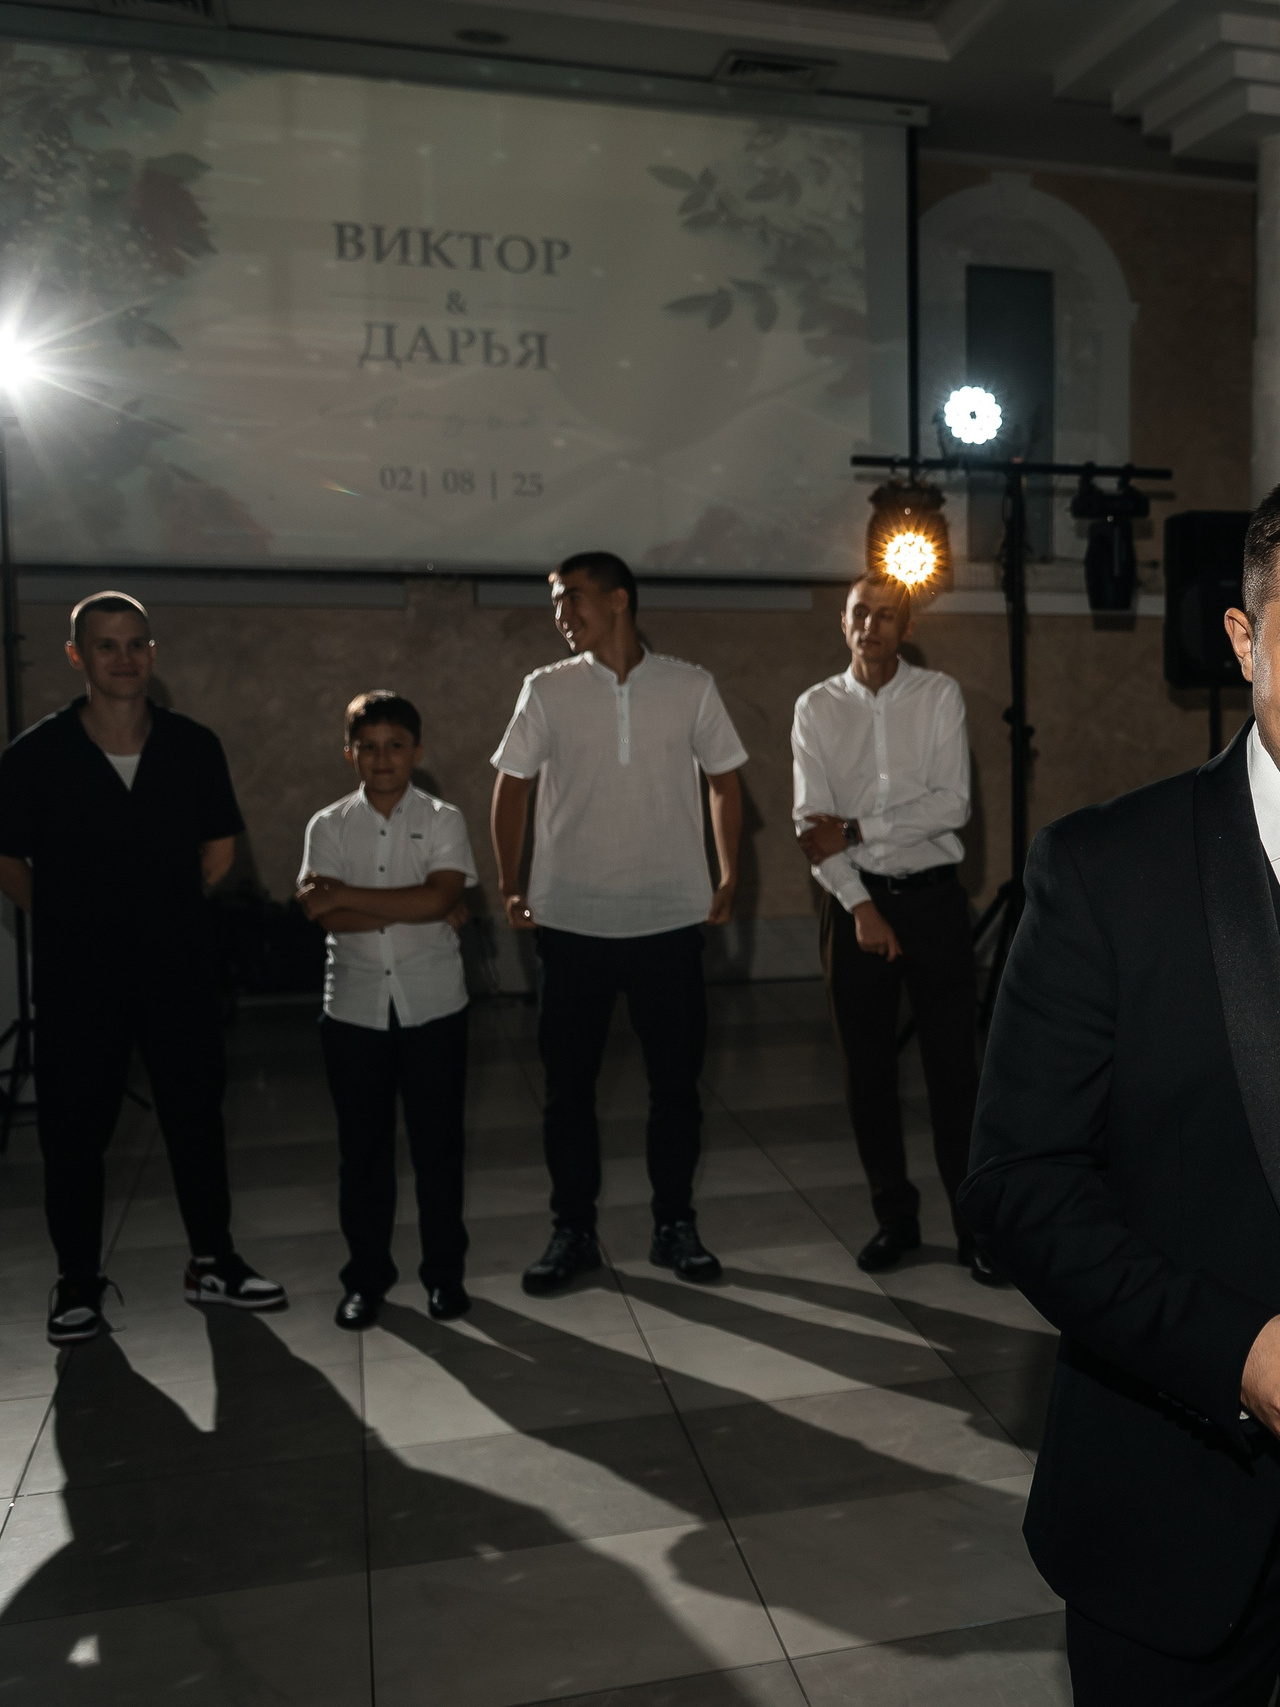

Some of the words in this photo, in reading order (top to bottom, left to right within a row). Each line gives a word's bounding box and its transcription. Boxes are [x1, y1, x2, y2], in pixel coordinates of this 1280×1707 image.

[333, 222, 571, 276] ВИКТОР
[446, 289, 467, 315] &
[358, 321, 550, 371] ДАРЬЯ
[442, 467, 475, 493] 08
[513, 472, 543, 497] 25
